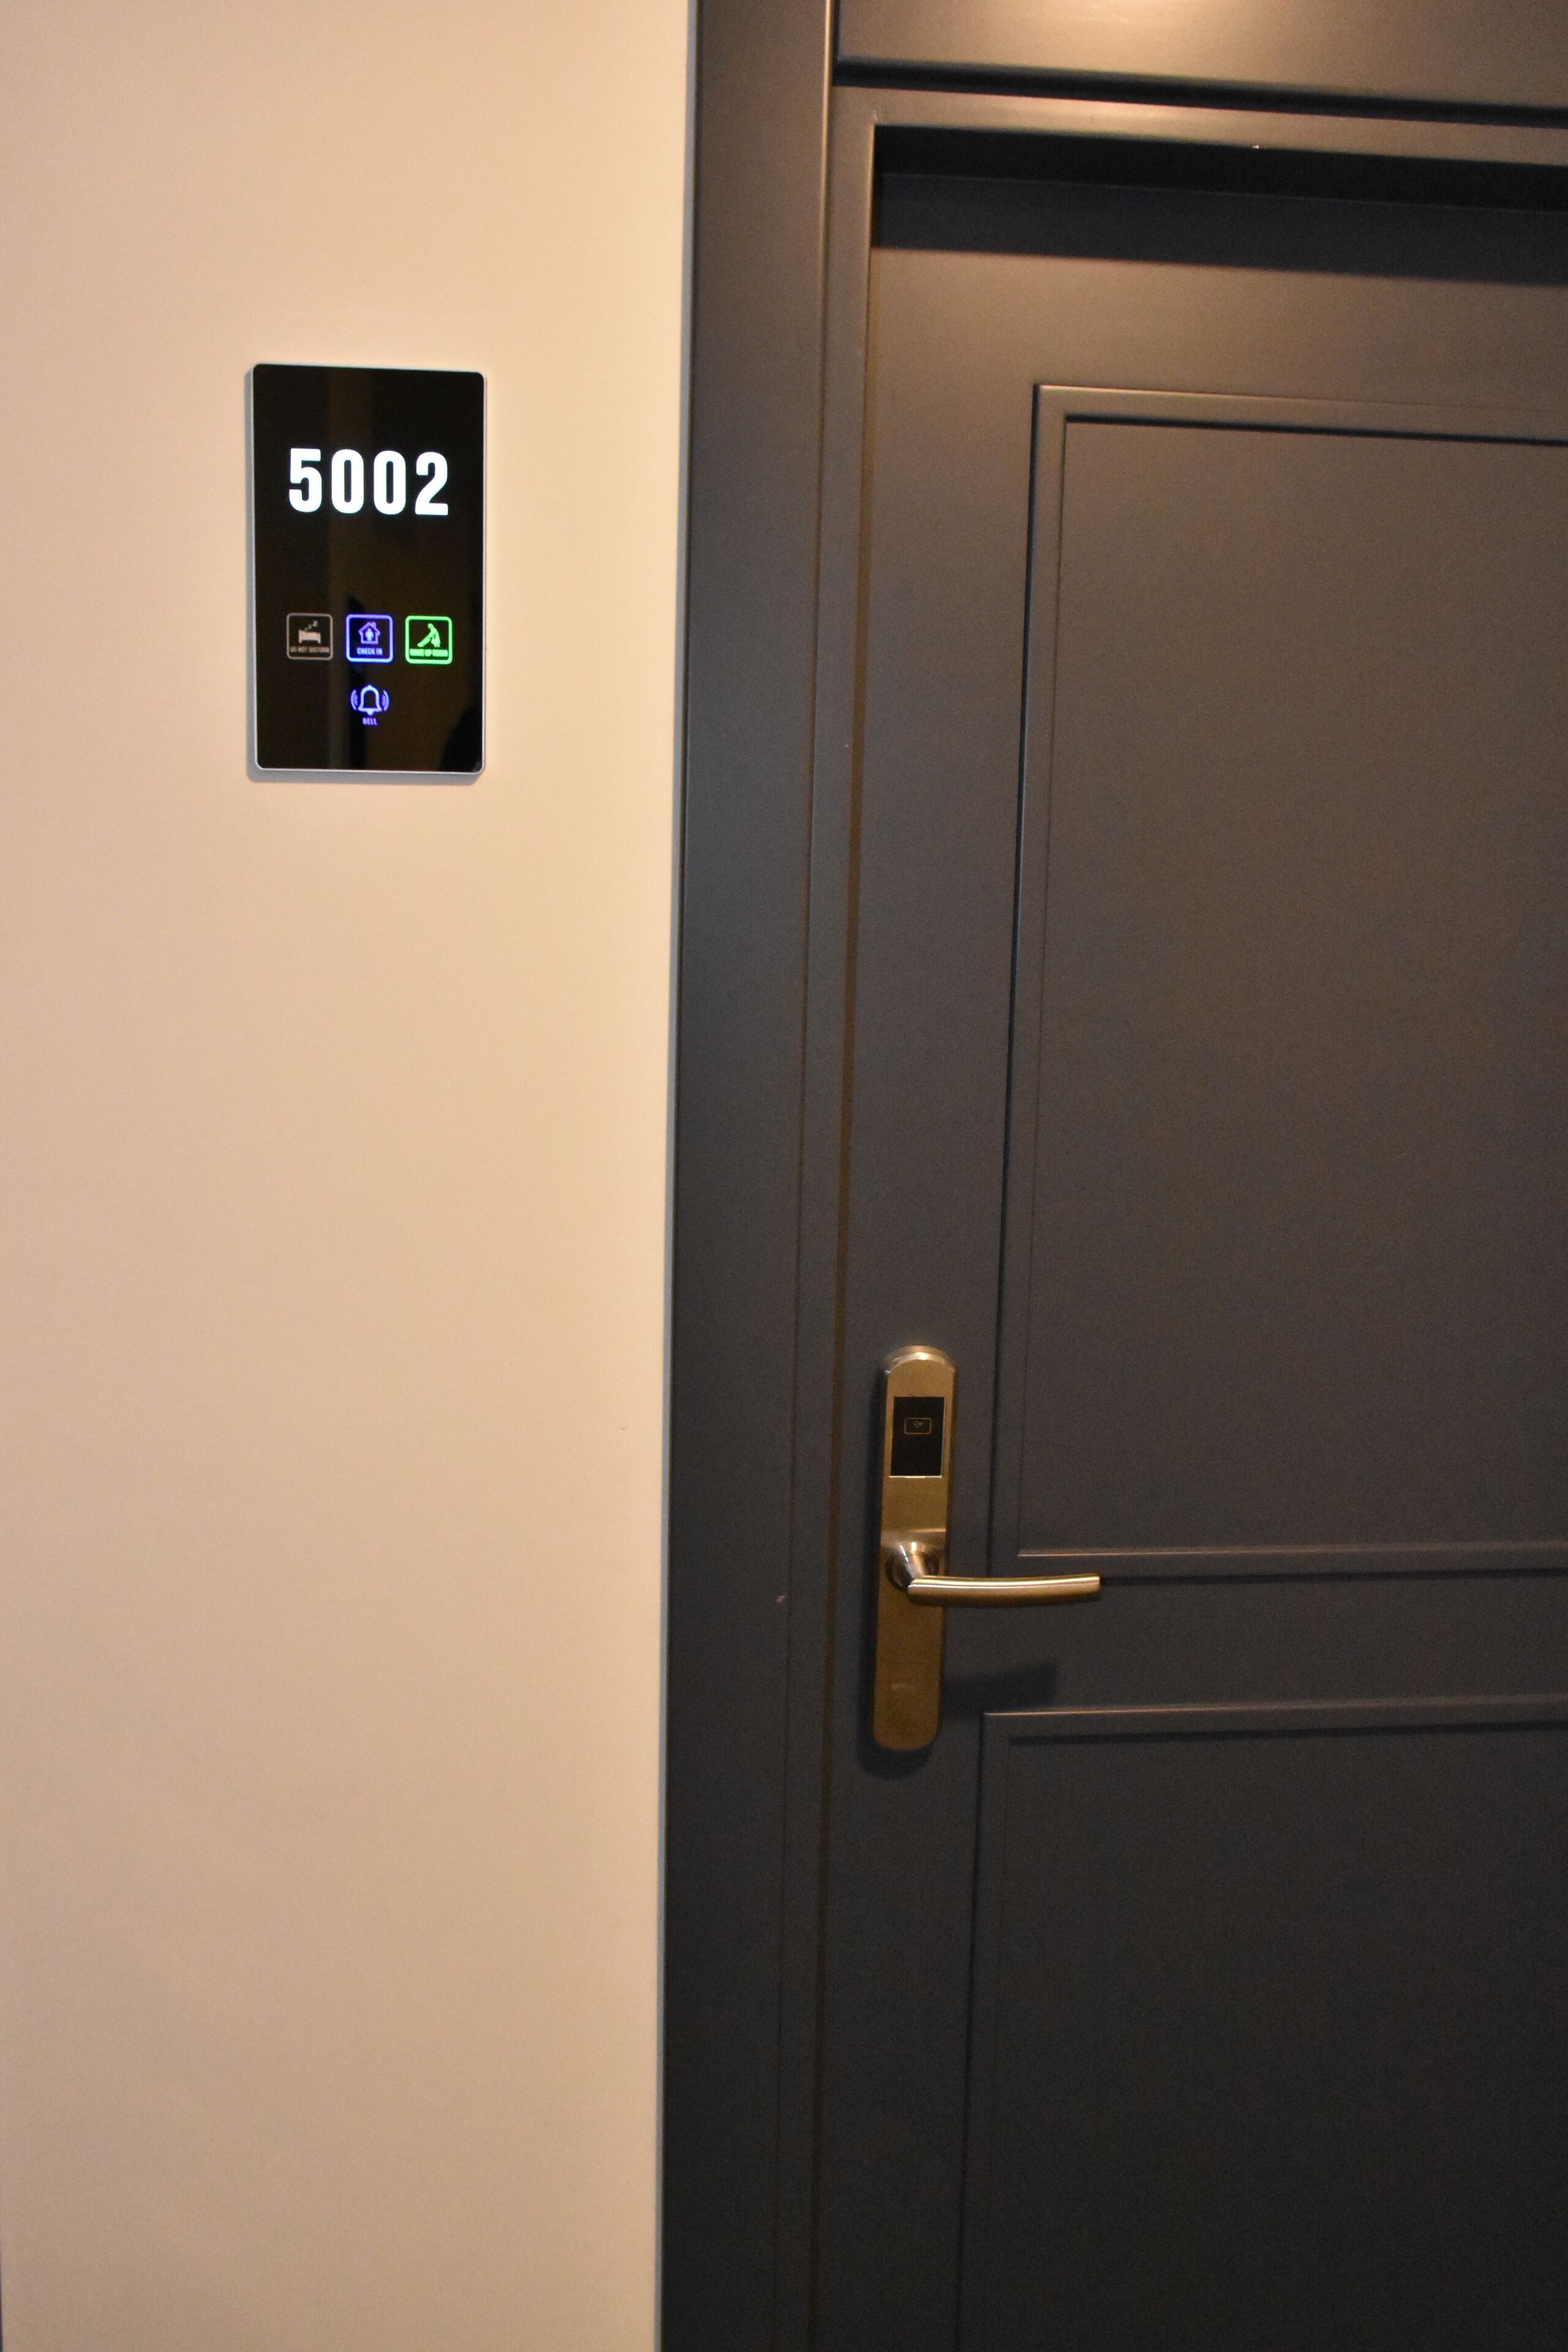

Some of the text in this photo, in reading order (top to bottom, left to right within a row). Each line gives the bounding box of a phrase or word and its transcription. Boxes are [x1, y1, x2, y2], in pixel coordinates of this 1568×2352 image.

[289, 448, 449, 516] 5002
[356, 647, 375, 655] CHECK
[362, 717, 378, 726] BELL
